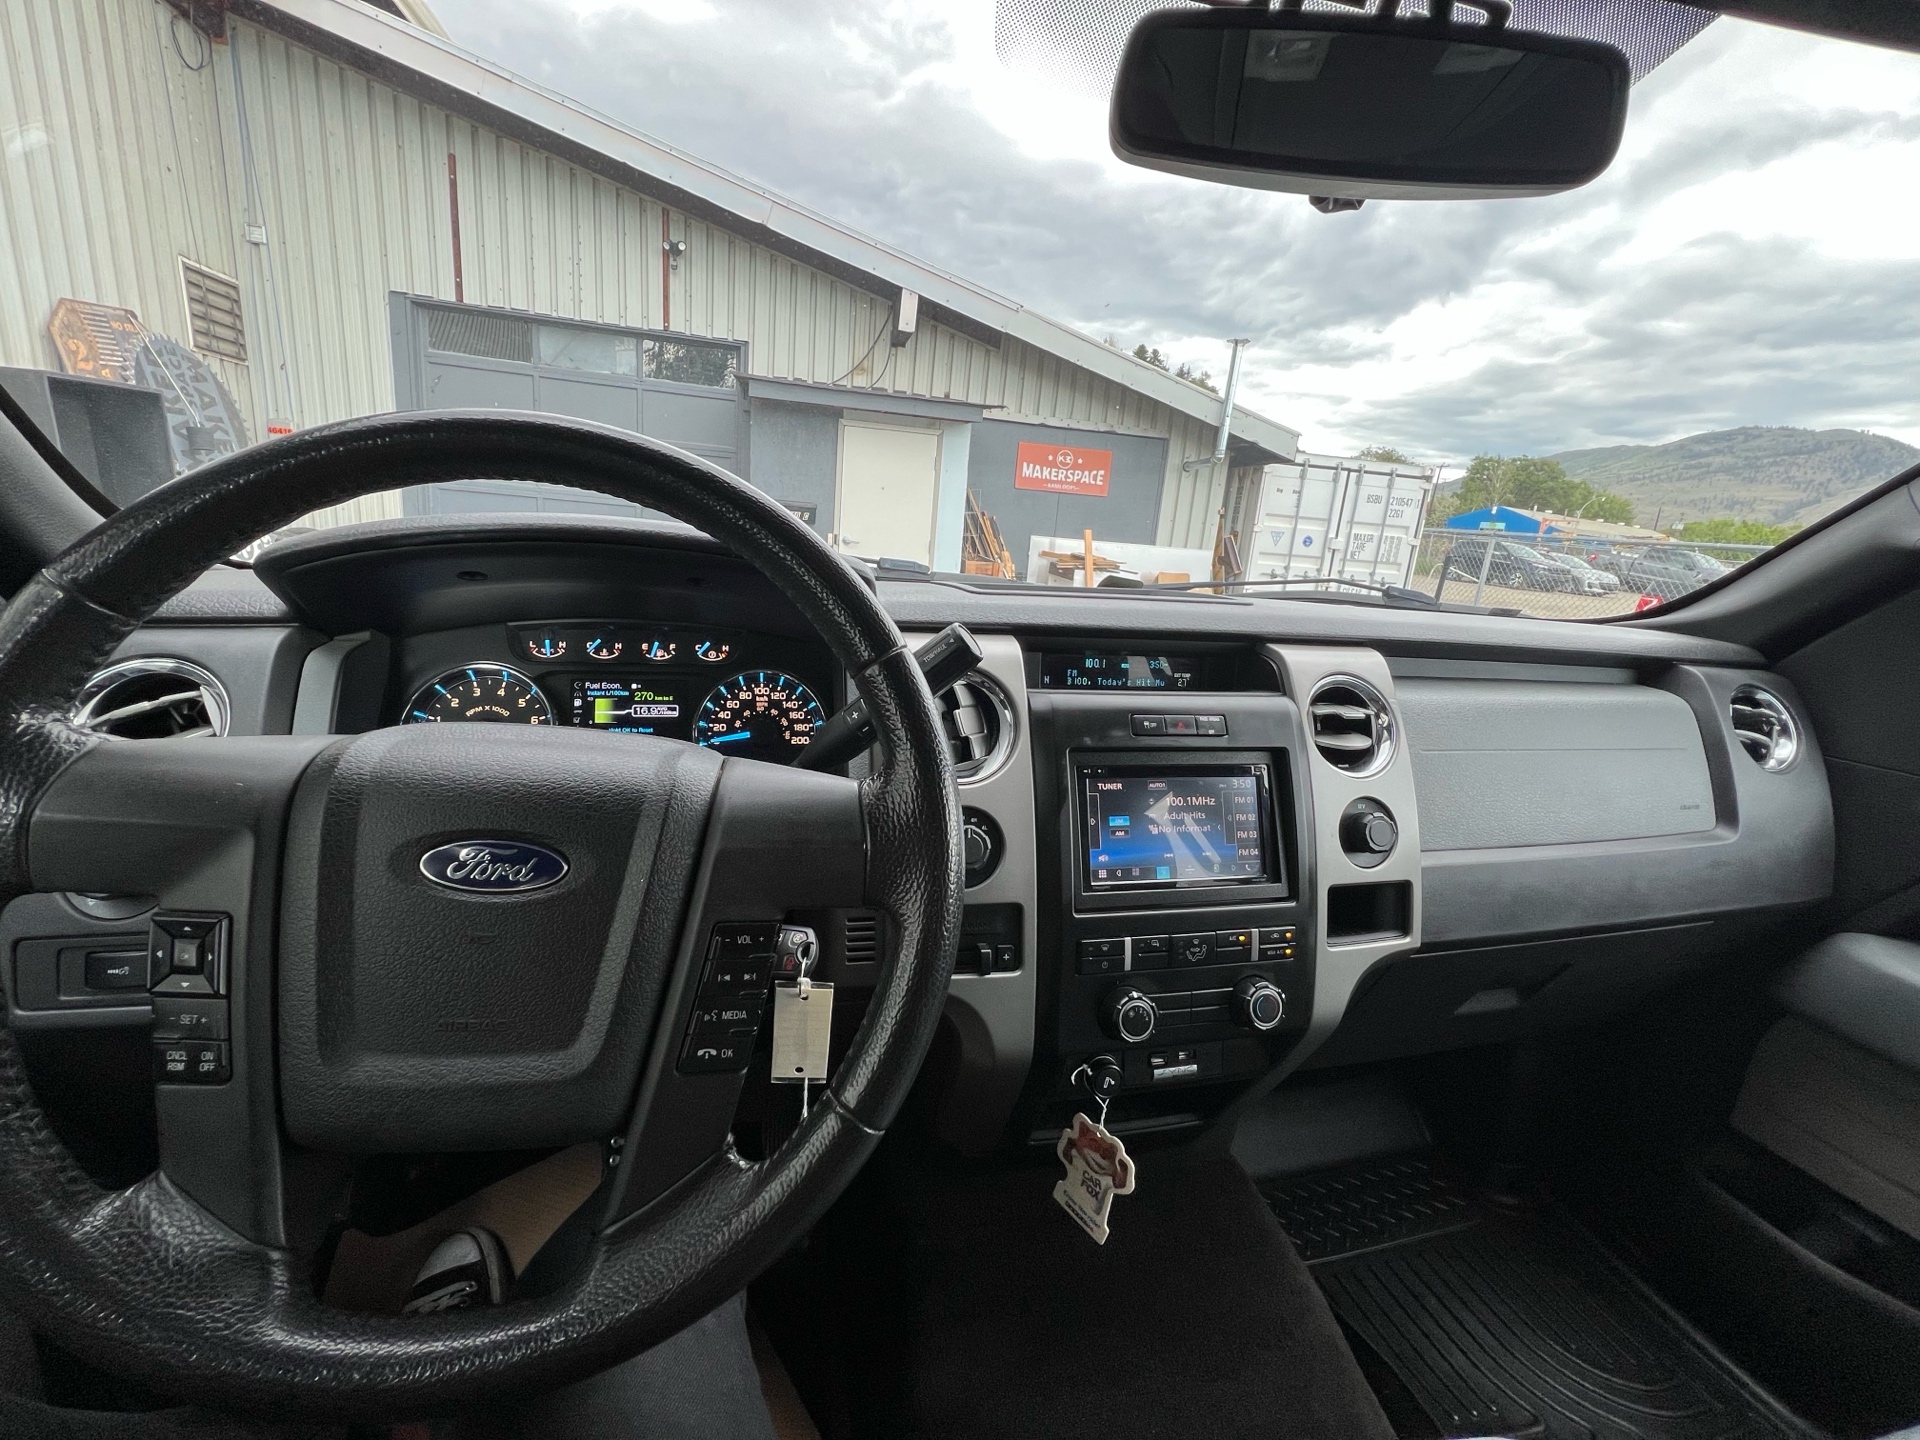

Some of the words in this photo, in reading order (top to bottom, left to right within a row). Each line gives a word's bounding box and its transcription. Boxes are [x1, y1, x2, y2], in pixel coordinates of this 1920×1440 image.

[1022, 462, 1104, 486] MAKERSPACE
[1366, 494, 1382, 504] BSBU
[1390, 496, 1414, 508] 210547
[1388, 508, 1404, 518] 22G1
[1098, 678, 1130, 686] Today's
[634, 692, 654, 700] 270
[451, 699, 459, 707] 2
[518, 699, 526, 707] 5
[466, 706, 482, 716] RPM
[492, 706, 510, 716] 1000
[636, 707, 656, 715] 16.9
[531, 716, 538, 724] 6
[1233, 780, 1251, 788] 3:50
[1166, 796, 1216, 806] 100.1MHz
[1164, 812, 1187, 820] Adult
[1190, 811, 1206, 819] Hits
[447, 845, 539, 882] Ford
[737, 936, 752, 944] VOL
[180, 1014, 198, 1024] SET
[722, 1010, 747, 1020] MEDIA
[166, 1051, 188, 1060] CNCL
[201, 1051, 214, 1060] ON
[721, 1048, 733, 1058] OK
[167, 1062, 185, 1071] RSM
[200, 1062, 215, 1071] OFF
[1082, 1170, 1102, 1190] CAR
[1081, 1179, 1100, 1201] FOX
